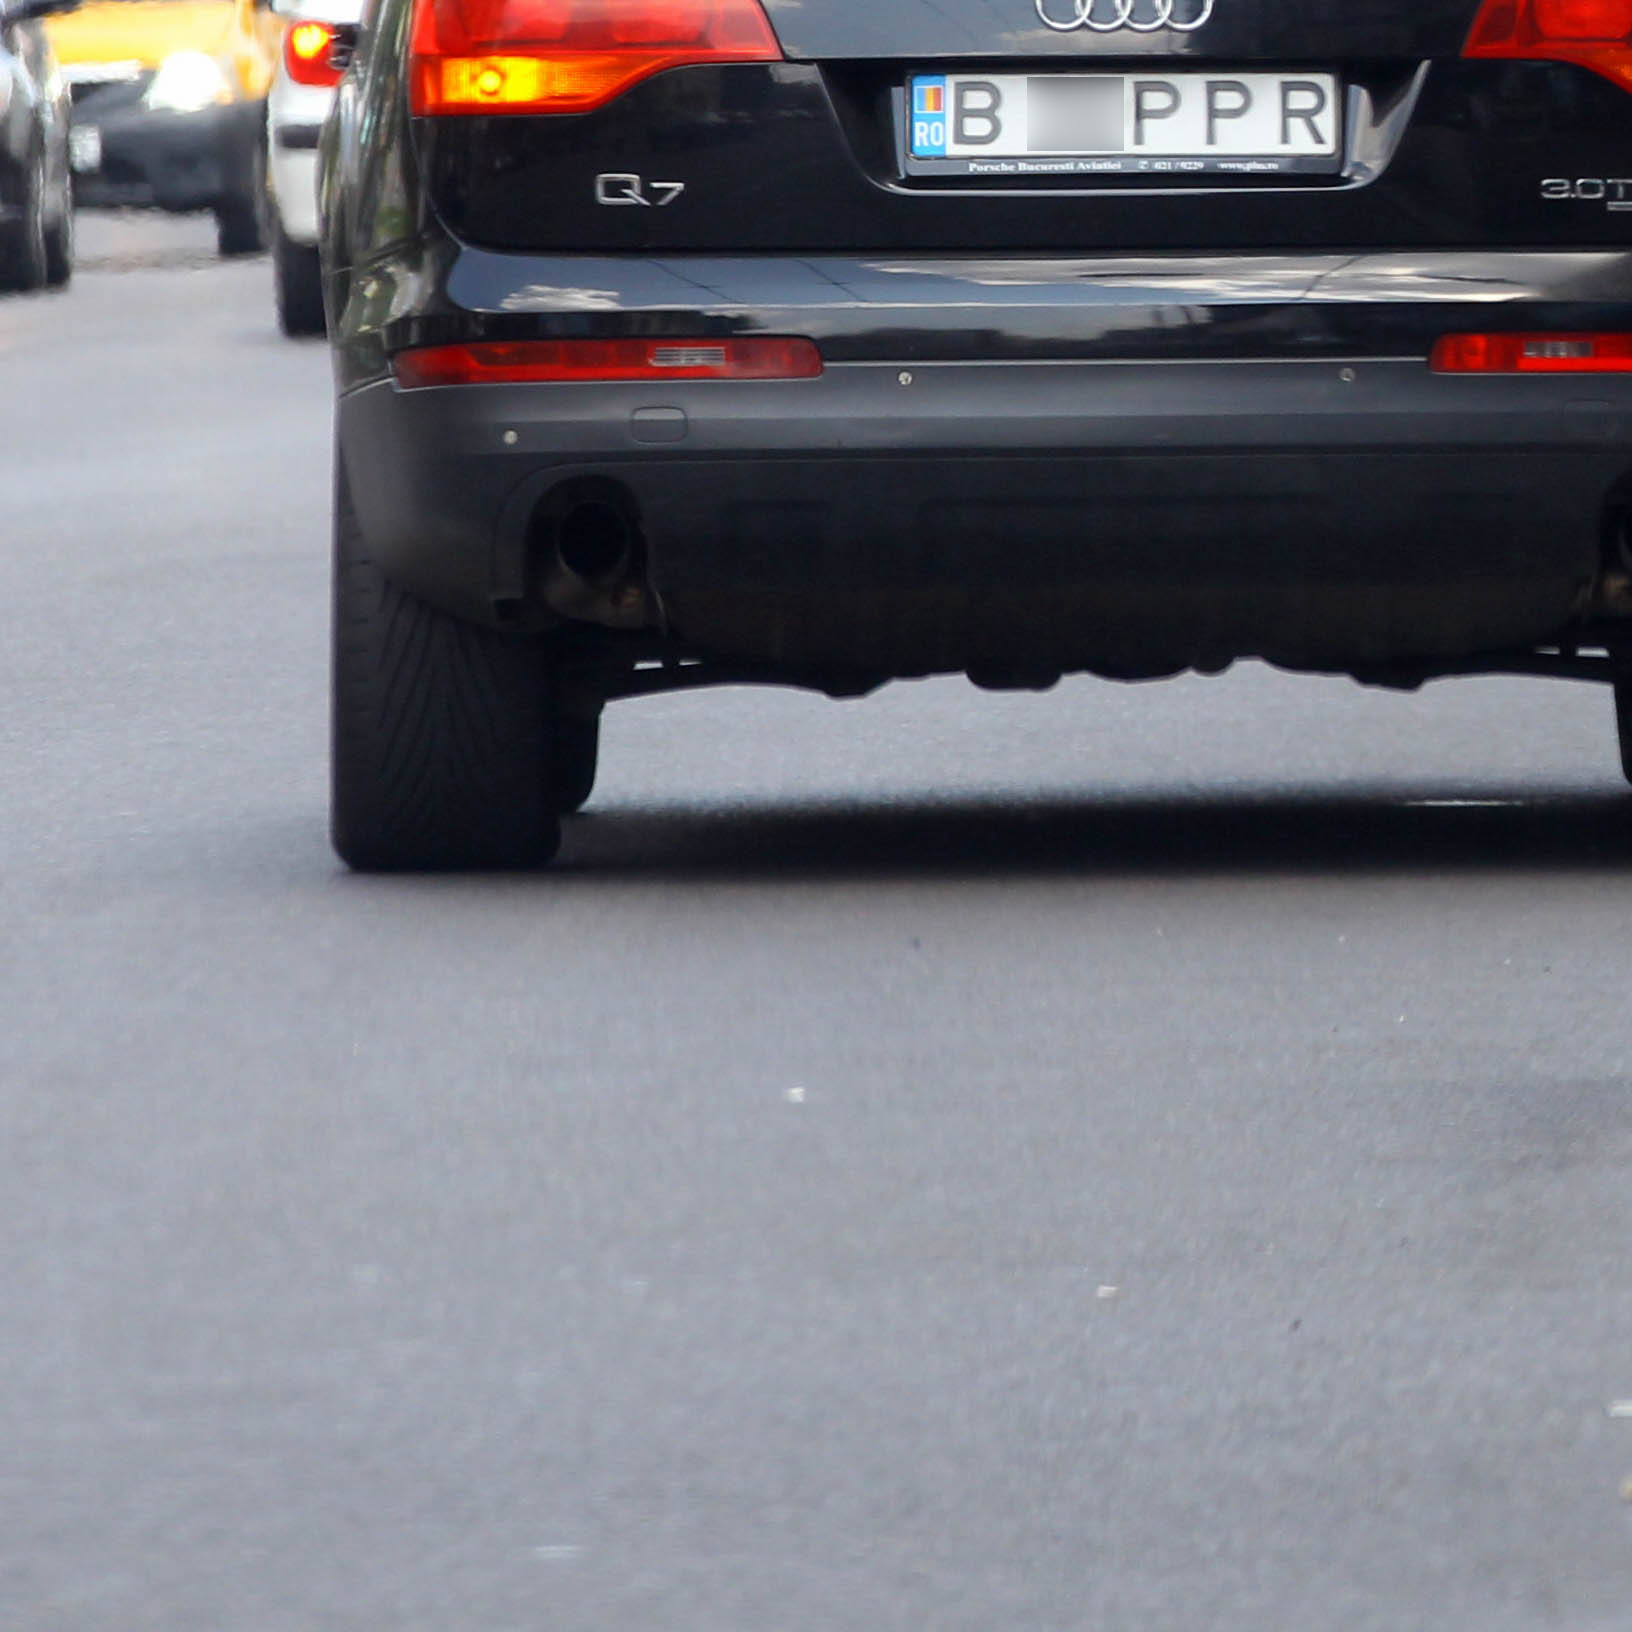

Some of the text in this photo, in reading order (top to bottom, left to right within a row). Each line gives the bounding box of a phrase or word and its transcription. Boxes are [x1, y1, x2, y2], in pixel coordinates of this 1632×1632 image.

[952, 79, 1328, 146] B PPR
[914, 121, 945, 148] RO
[968, 161, 1016, 173] Porsche
[595, 172, 686, 206] Q7
